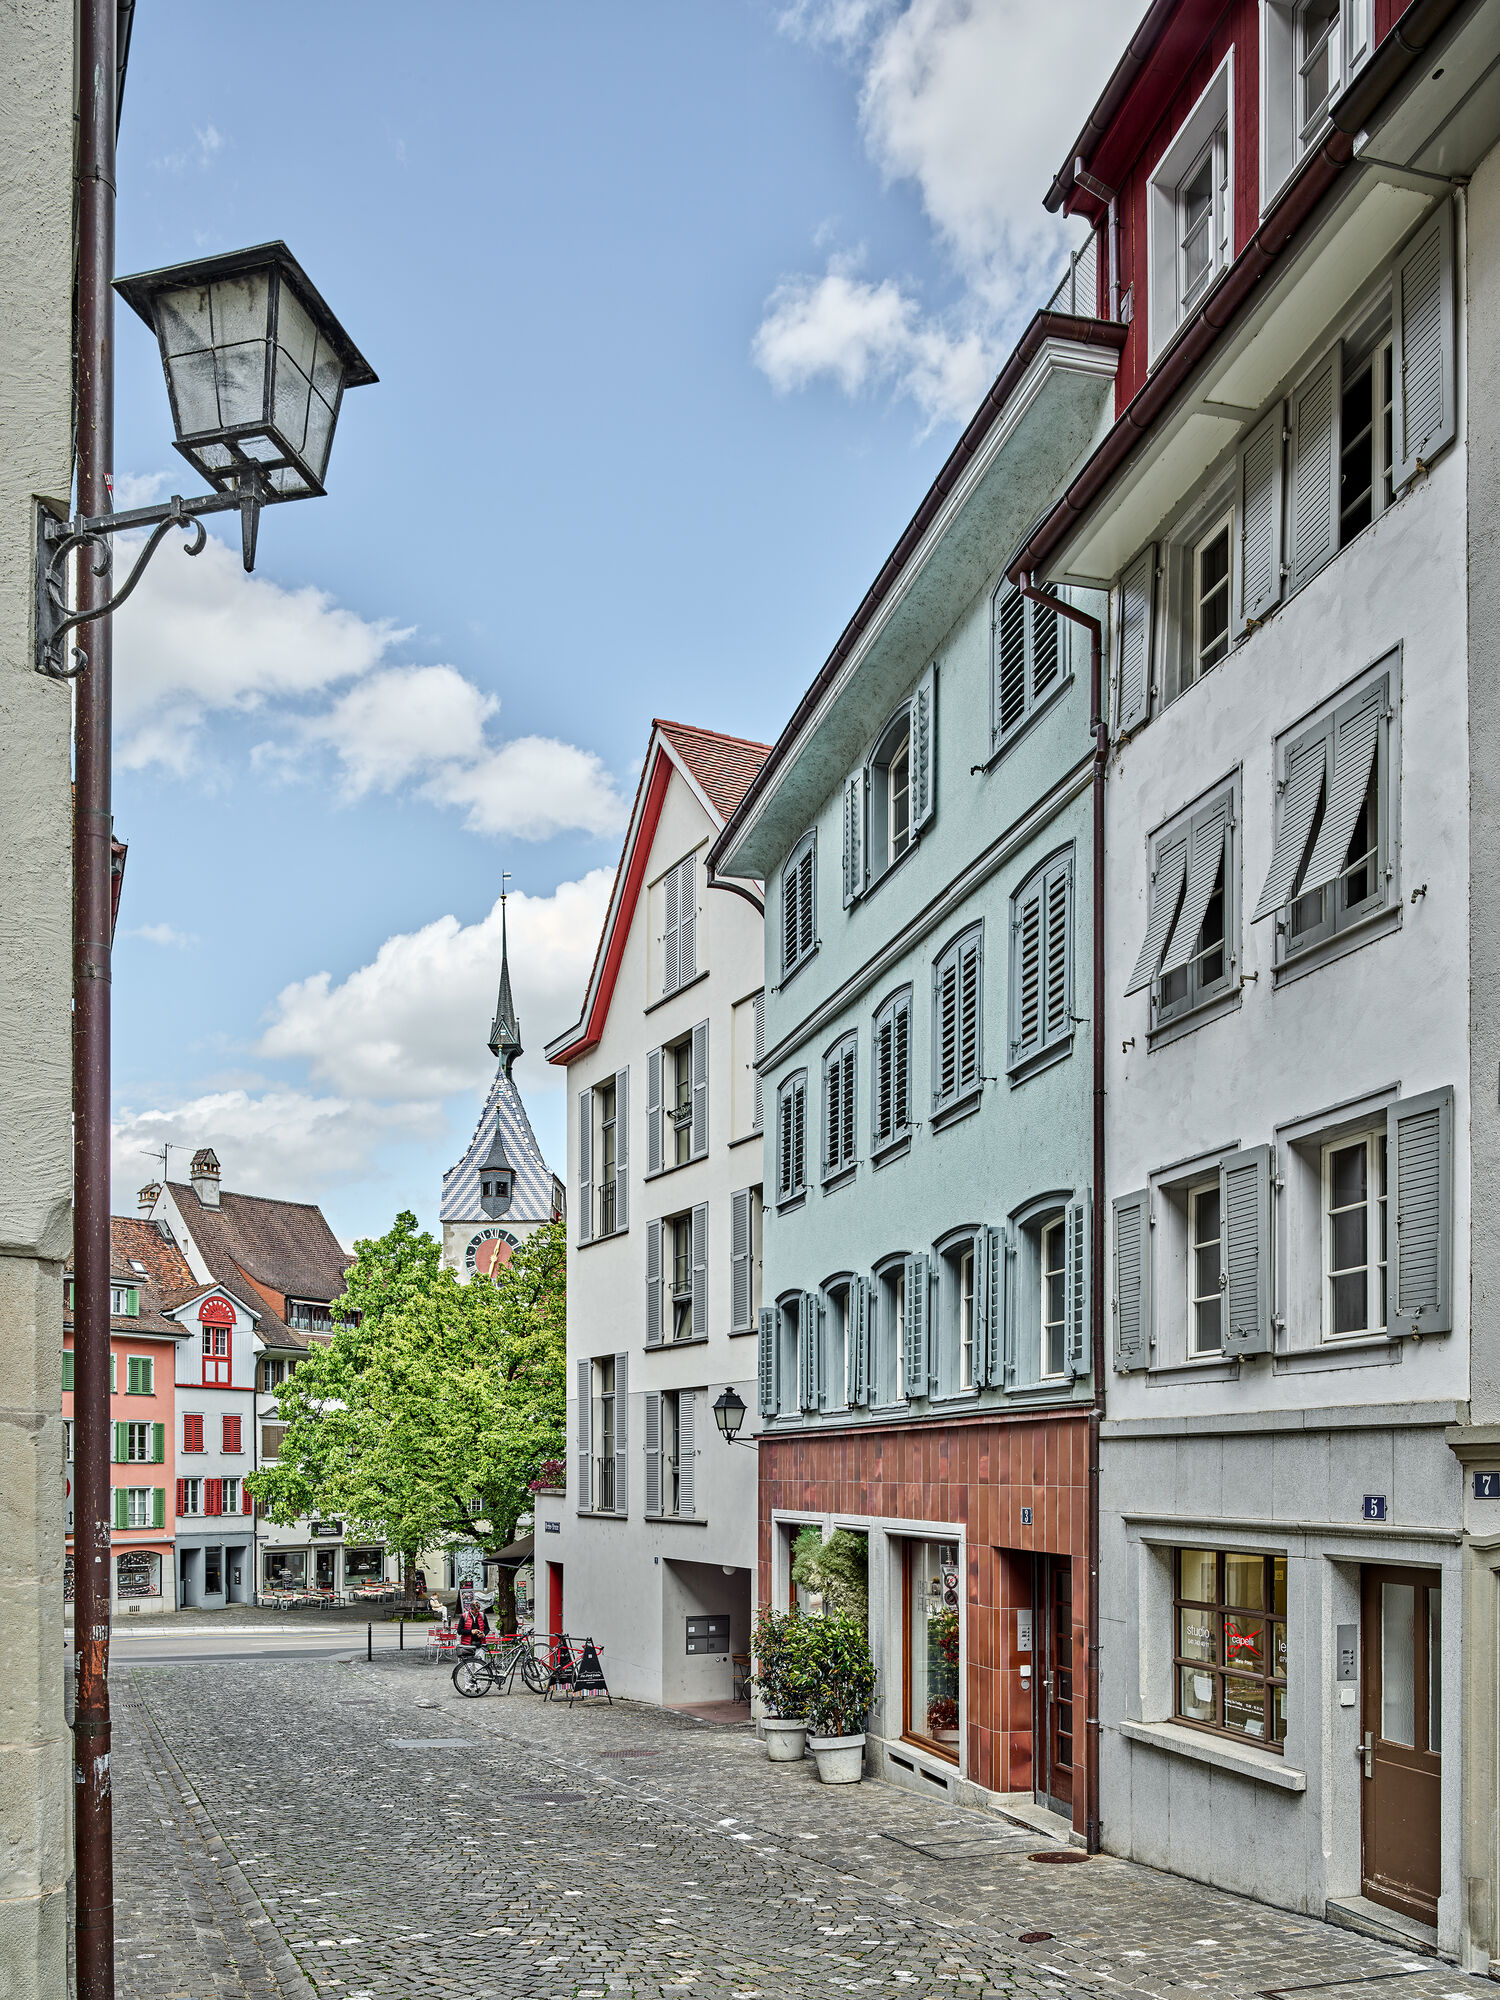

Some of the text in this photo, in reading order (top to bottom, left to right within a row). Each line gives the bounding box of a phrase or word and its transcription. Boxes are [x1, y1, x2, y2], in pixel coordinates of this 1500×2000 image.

[1482, 1475, 1492, 1495] 7
[1024, 1509, 1029, 1523] 3
[1370, 1498, 1378, 1517] 5
[1186, 1624, 1210, 1639] studio
[1231, 1636, 1254, 1647] capelli
